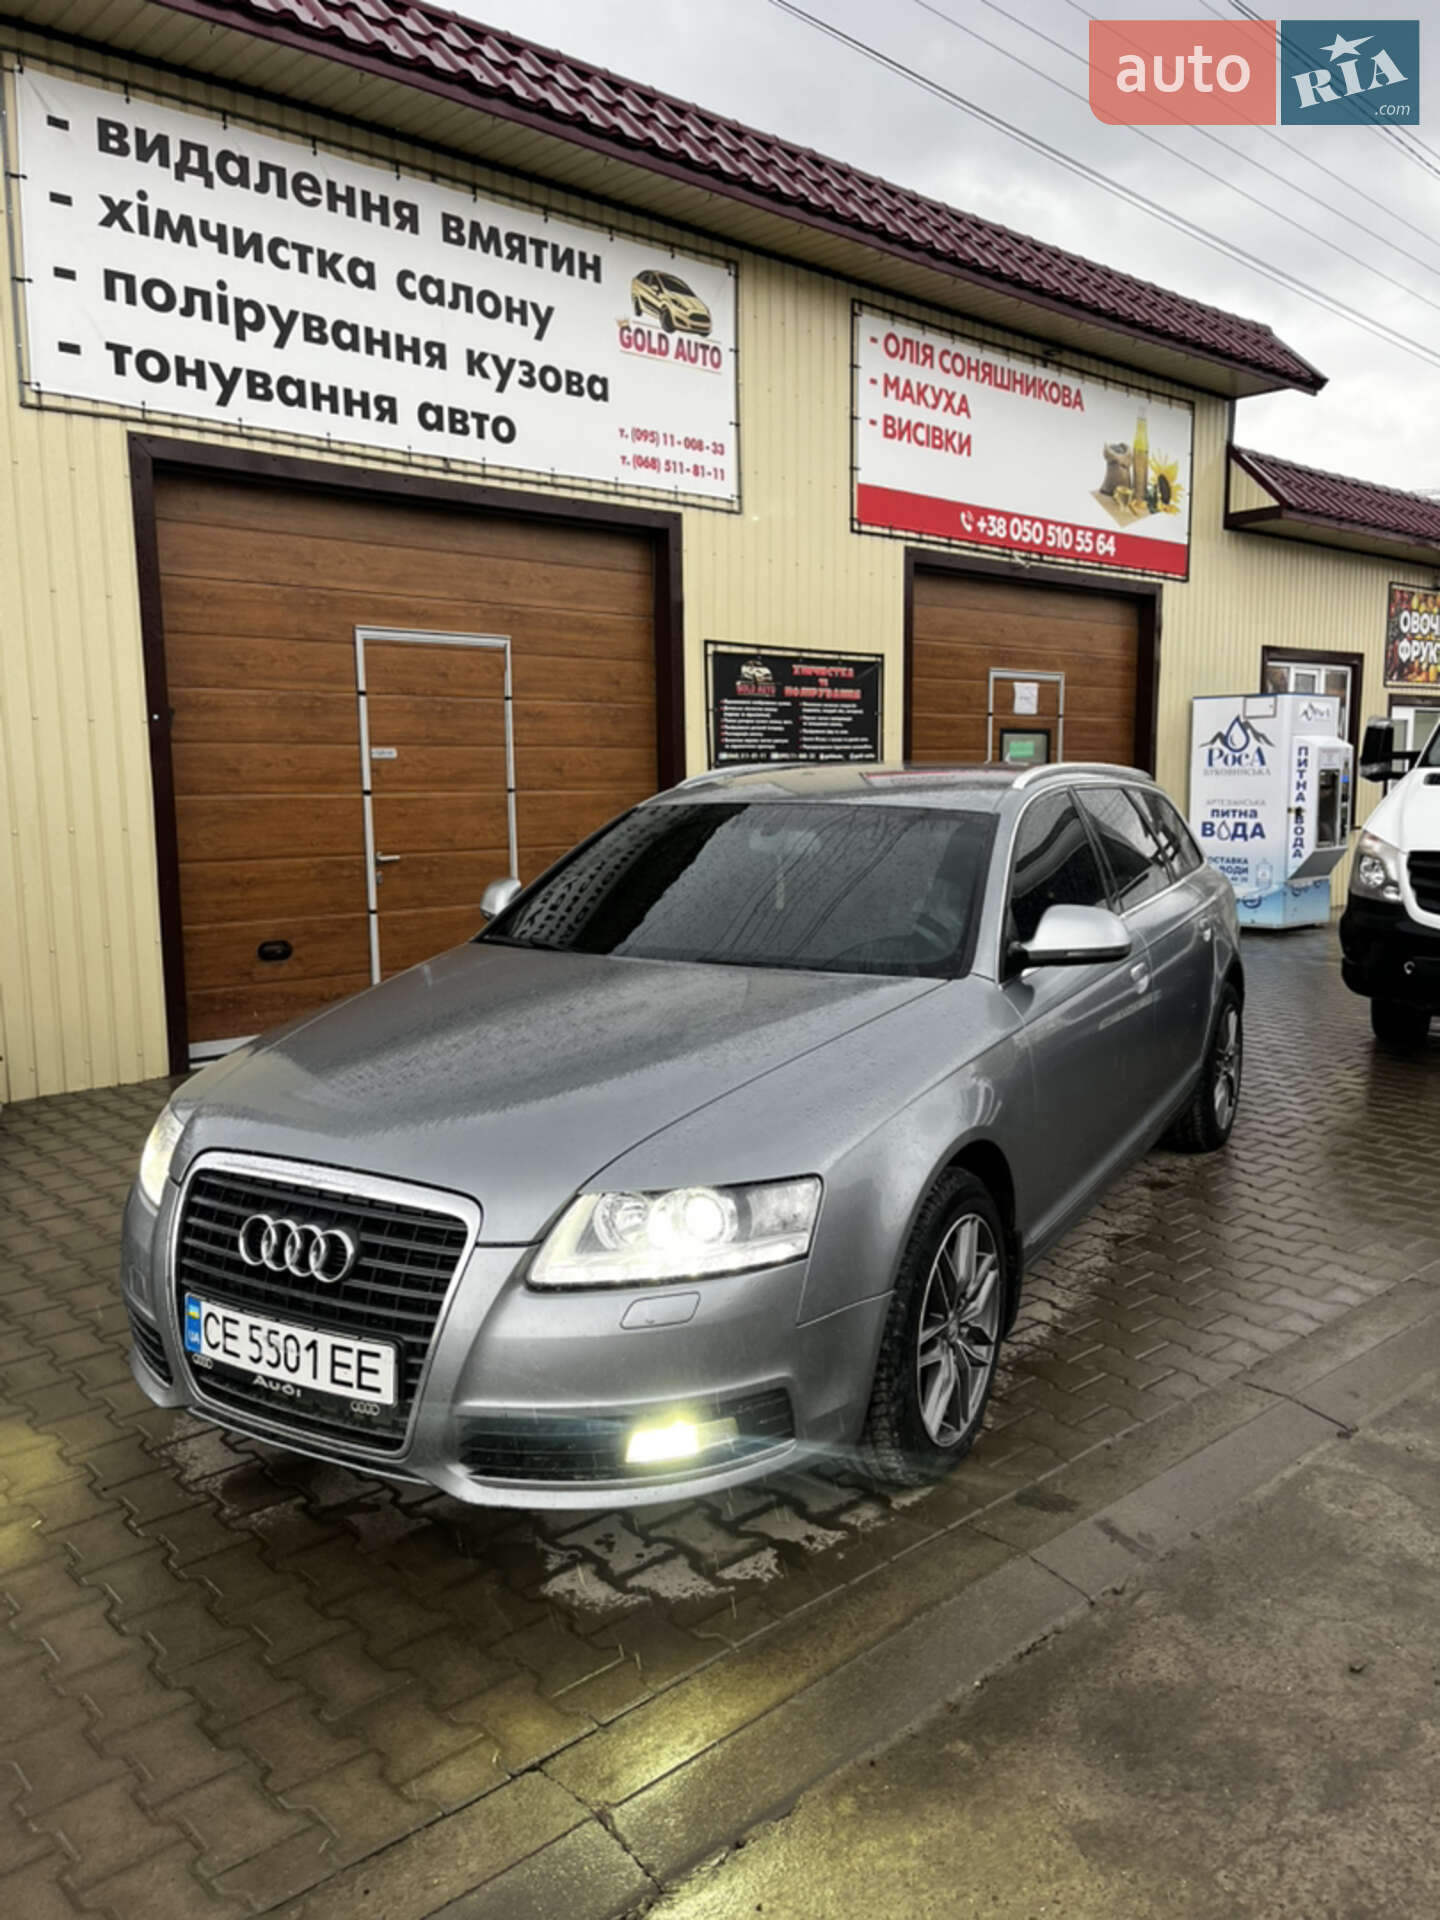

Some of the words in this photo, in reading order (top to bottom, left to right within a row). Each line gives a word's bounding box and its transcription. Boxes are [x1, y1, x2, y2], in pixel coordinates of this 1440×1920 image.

[97, 116, 420, 235] видалення
[441, 211, 602, 284] вмятин
[99, 189, 376, 291] хімчистка
[396, 268, 555, 341] салону
[103, 267, 448, 371] полірування
[466, 347, 610, 403] кузова
[619, 325, 670, 358] GOLD
[674, 336, 722, 370] AUTO
[105, 340, 399, 425] тонування
[417, 400, 516, 445] авто
[883, 331, 934, 370] ОЛІЯ
[938, 349, 1085, 412] СОНЯШНИКОВА
[883, 373, 972, 419] МАКУХА
[631, 427, 660, 448] (095)
[882, 413, 972, 458] ВИСІВКИ
[632, 453, 661, 474] (068)
[977, 514, 1007, 539] +38
[1009, 517, 1044, 545] 050
[1046, 524, 1074, 549] 510
[1075, 528, 1094, 553] 55
[1096, 533, 1117, 557] 64
[1399, 610, 1439, 635] ОВОЧ
[1294, 746, 1308, 802] ПИТНА
[1208, 856, 1249, 865] ОСТАВКА
[203, 1311, 241, 1359] CE
[248, 1323, 319, 1381] 5501
[329, 1343, 382, 1395] EE
